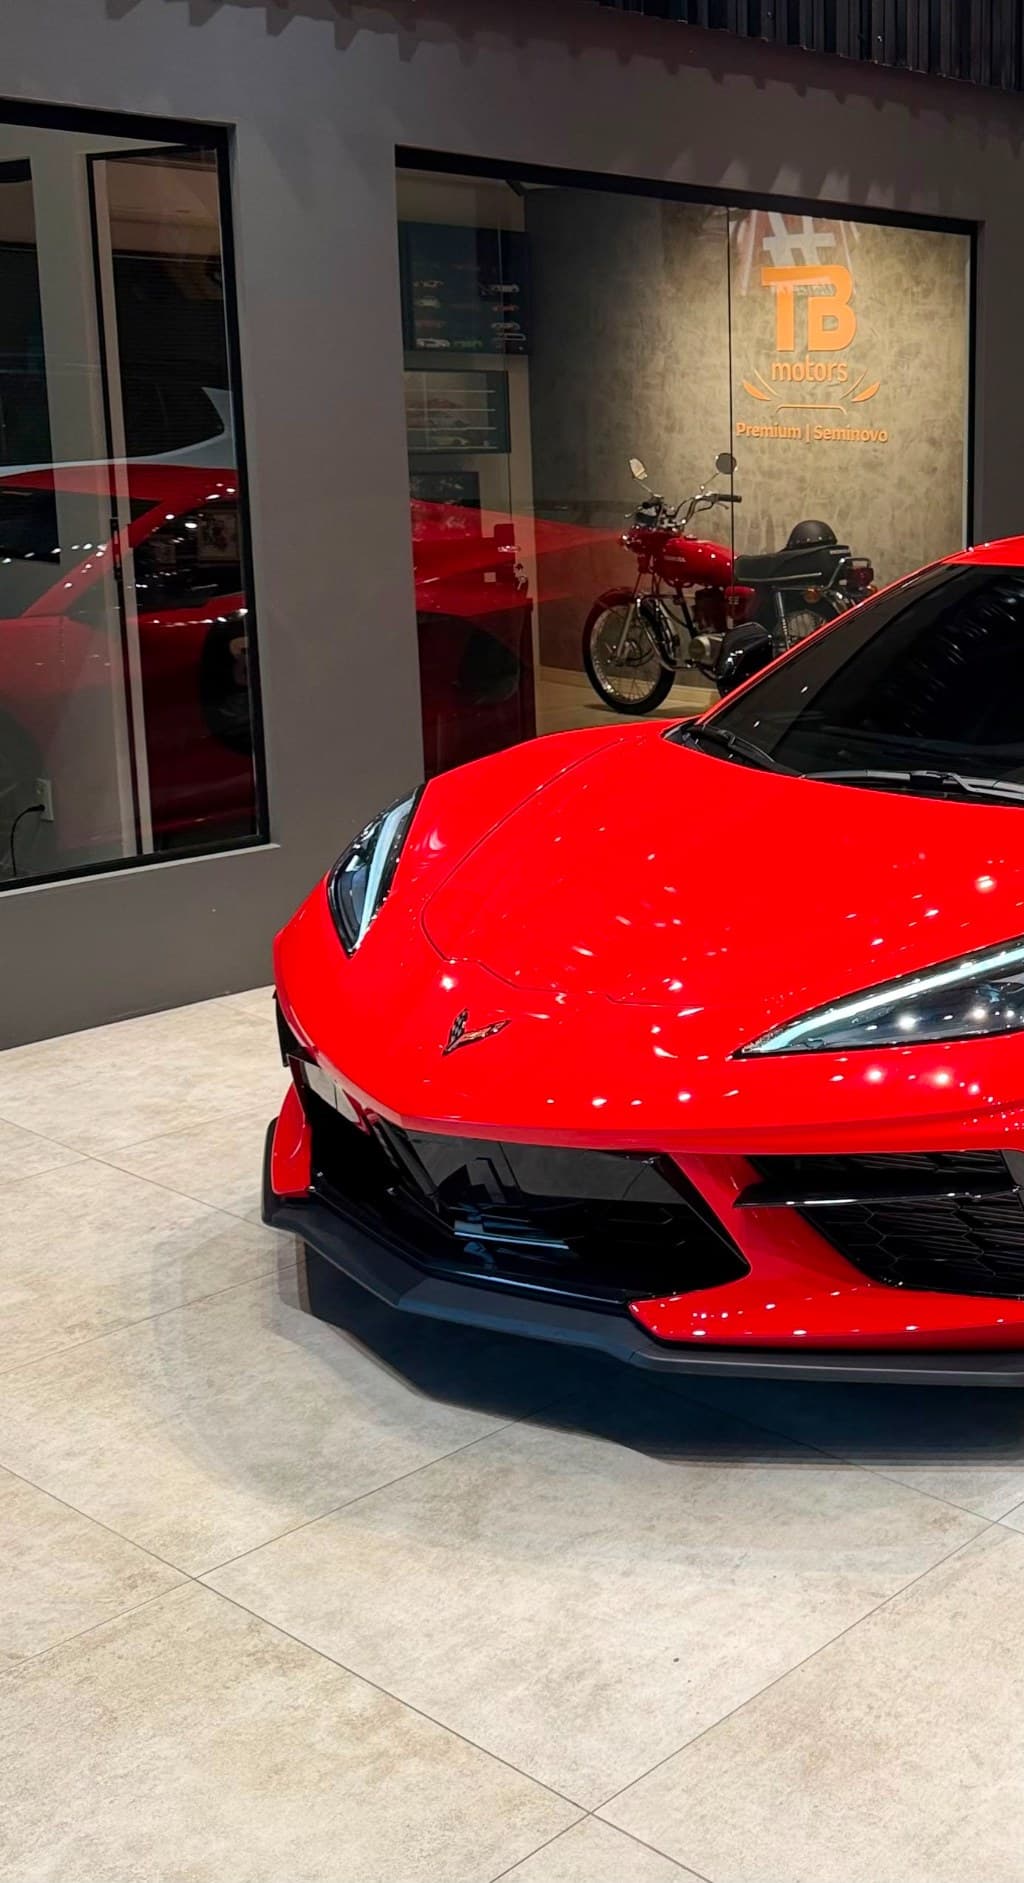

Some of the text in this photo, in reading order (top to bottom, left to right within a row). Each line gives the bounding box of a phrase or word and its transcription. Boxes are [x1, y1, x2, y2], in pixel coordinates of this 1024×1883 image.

[761, 264, 857, 352] TB
[771, 353, 849, 382] motors
[735, 421, 801, 440] Premium
[813, 424, 888, 443] Seminovo
